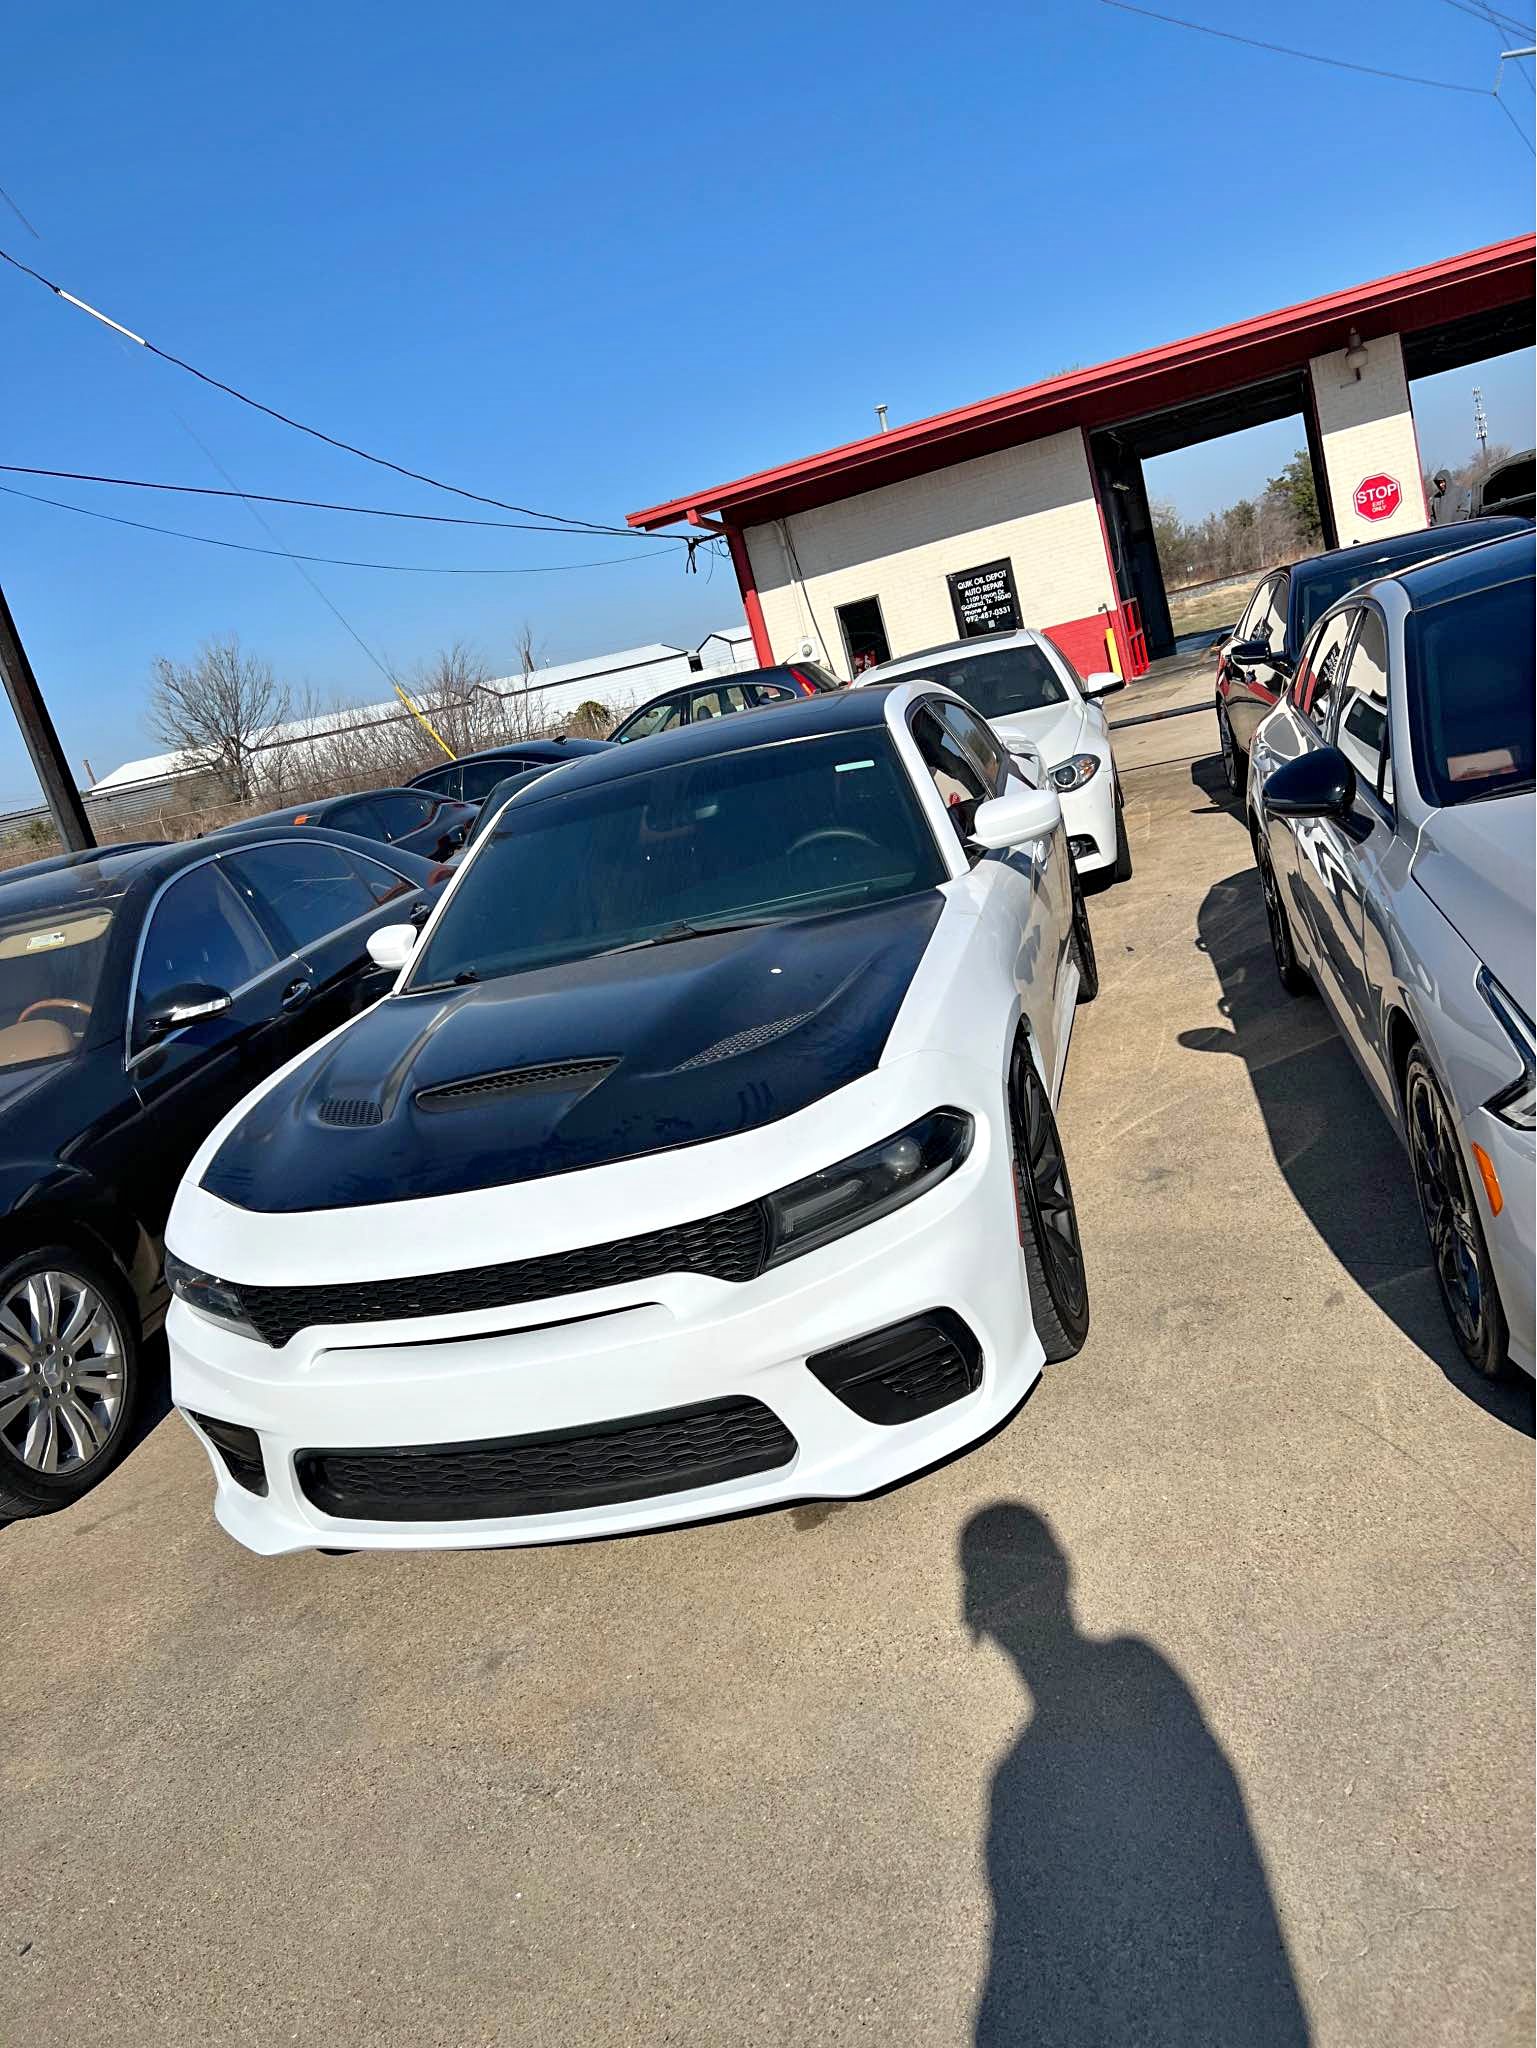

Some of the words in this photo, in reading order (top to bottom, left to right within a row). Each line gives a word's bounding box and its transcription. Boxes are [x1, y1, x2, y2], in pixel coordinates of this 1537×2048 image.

[1357, 483, 1397, 504] STOP
[1371, 504, 1387, 513] ONLY
[957, 579, 973, 590] QUIK
[974, 576, 985, 585] OIL
[985, 570, 1007, 583] DEPOT
[964, 586, 982, 597] AUTO
[982, 580, 1005, 592] REPAIR
[966, 595, 980, 604] 1109
[994, 592, 1012, 602] 75040
[964, 608, 981, 617] Phone
[965, 605, 1011, 624] 972-487-0331
